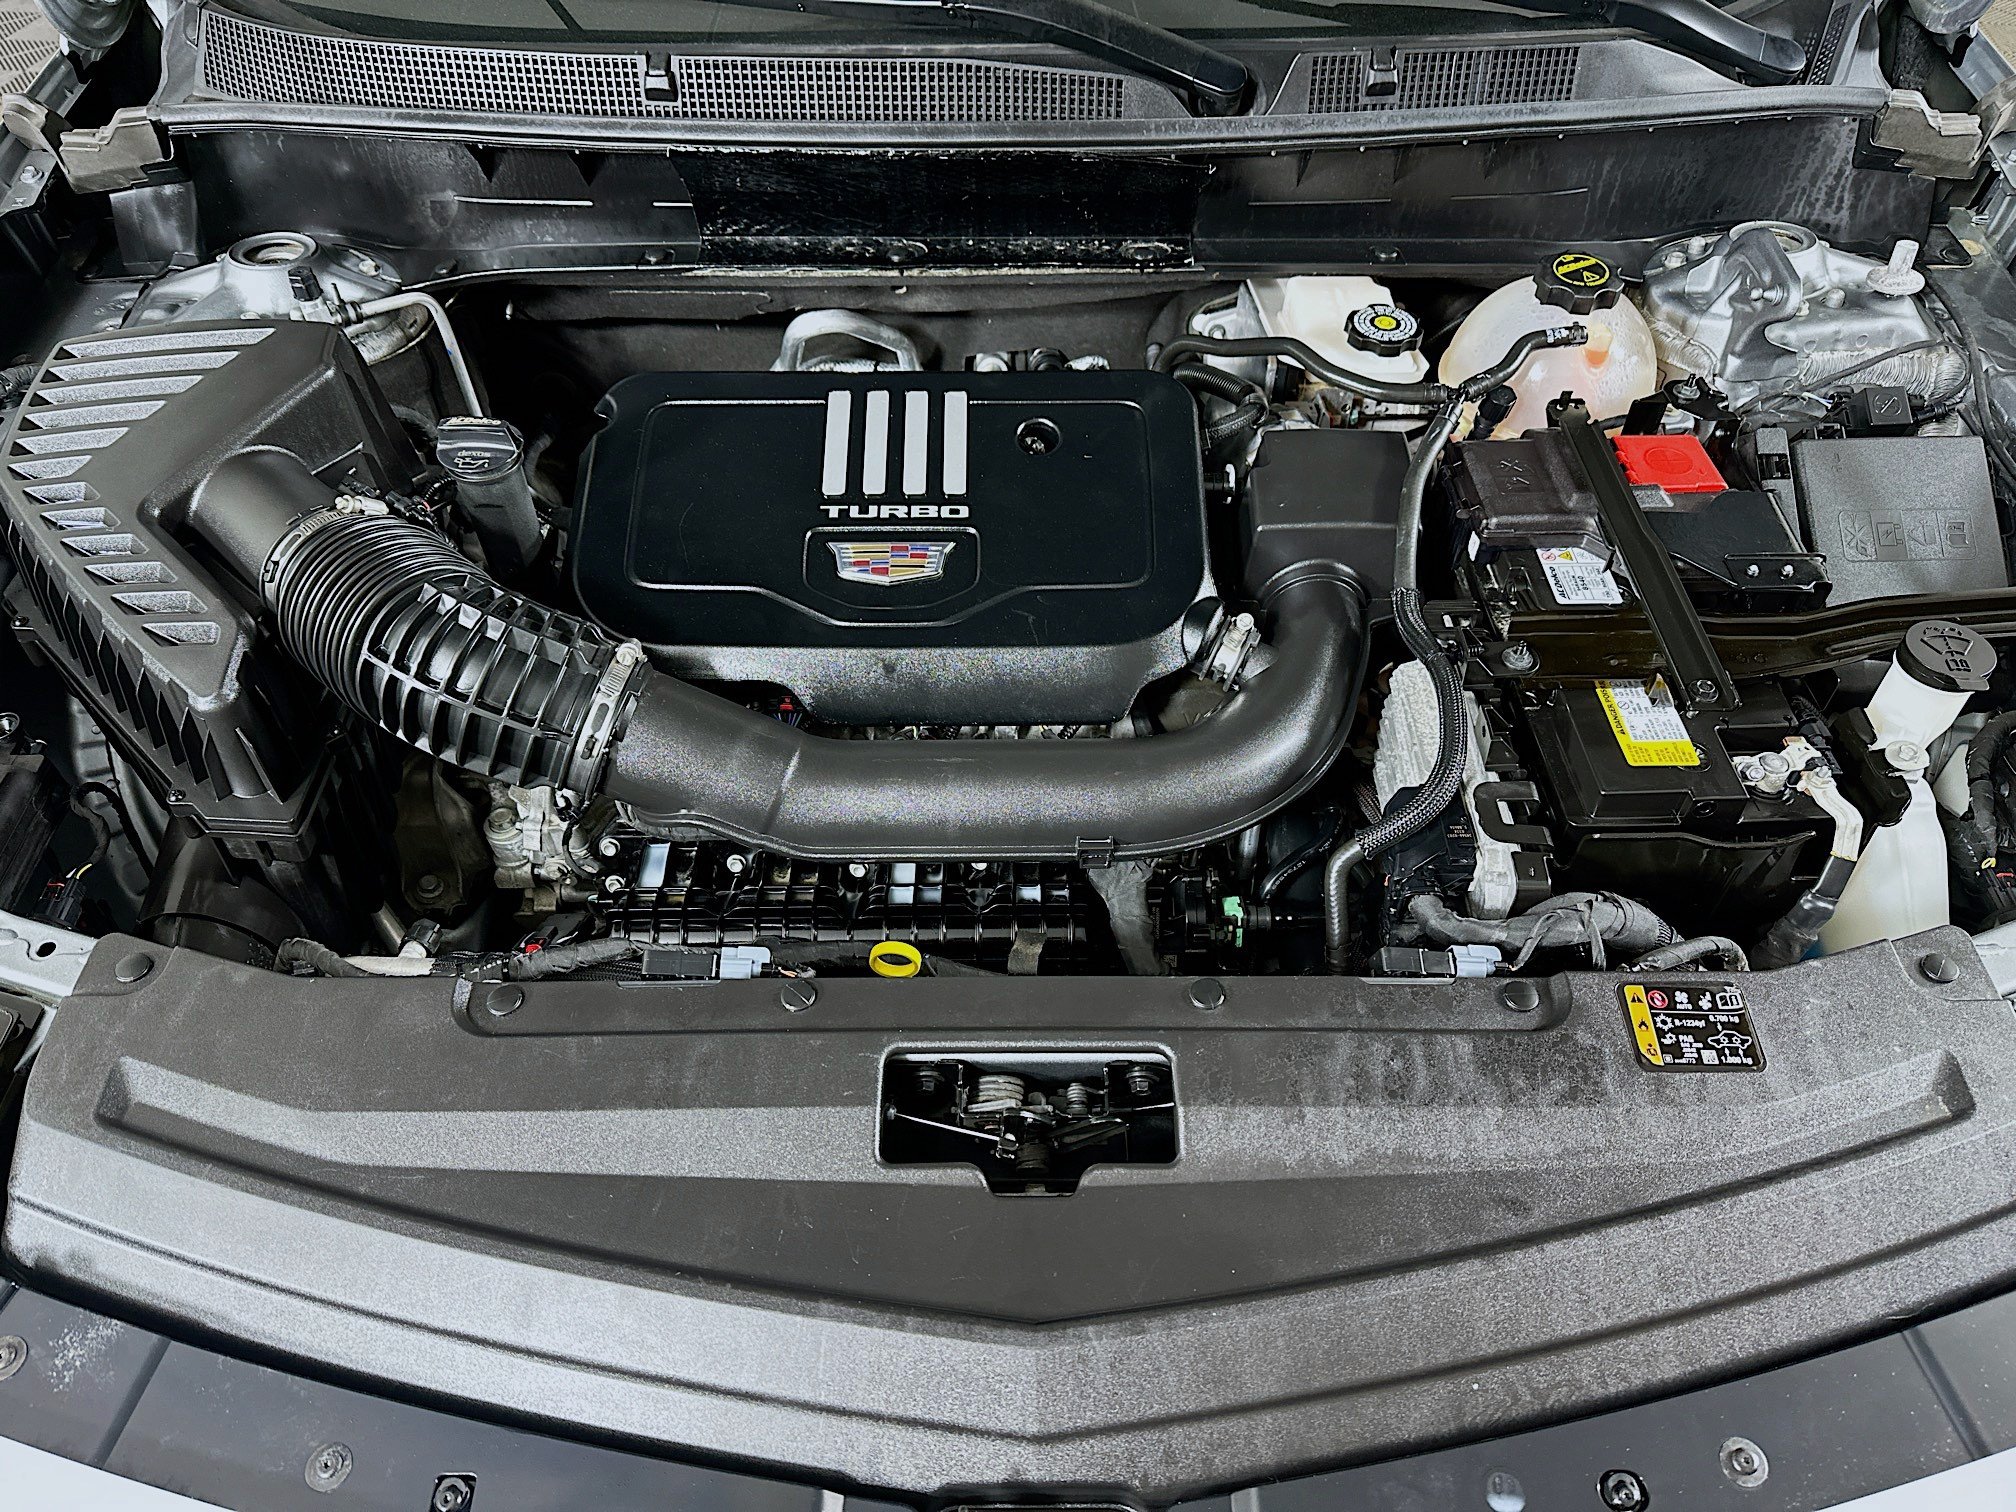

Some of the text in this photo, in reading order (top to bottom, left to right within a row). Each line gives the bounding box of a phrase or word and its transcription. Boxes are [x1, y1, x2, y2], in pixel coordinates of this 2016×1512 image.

[458, 449, 491, 458] dexos
[820, 505, 970, 519] TURBO
[1549, 566, 1567, 599] ACDelco
[1606, 703, 1623, 731] DANGER
[1728, 1015, 1740, 1024] kg
